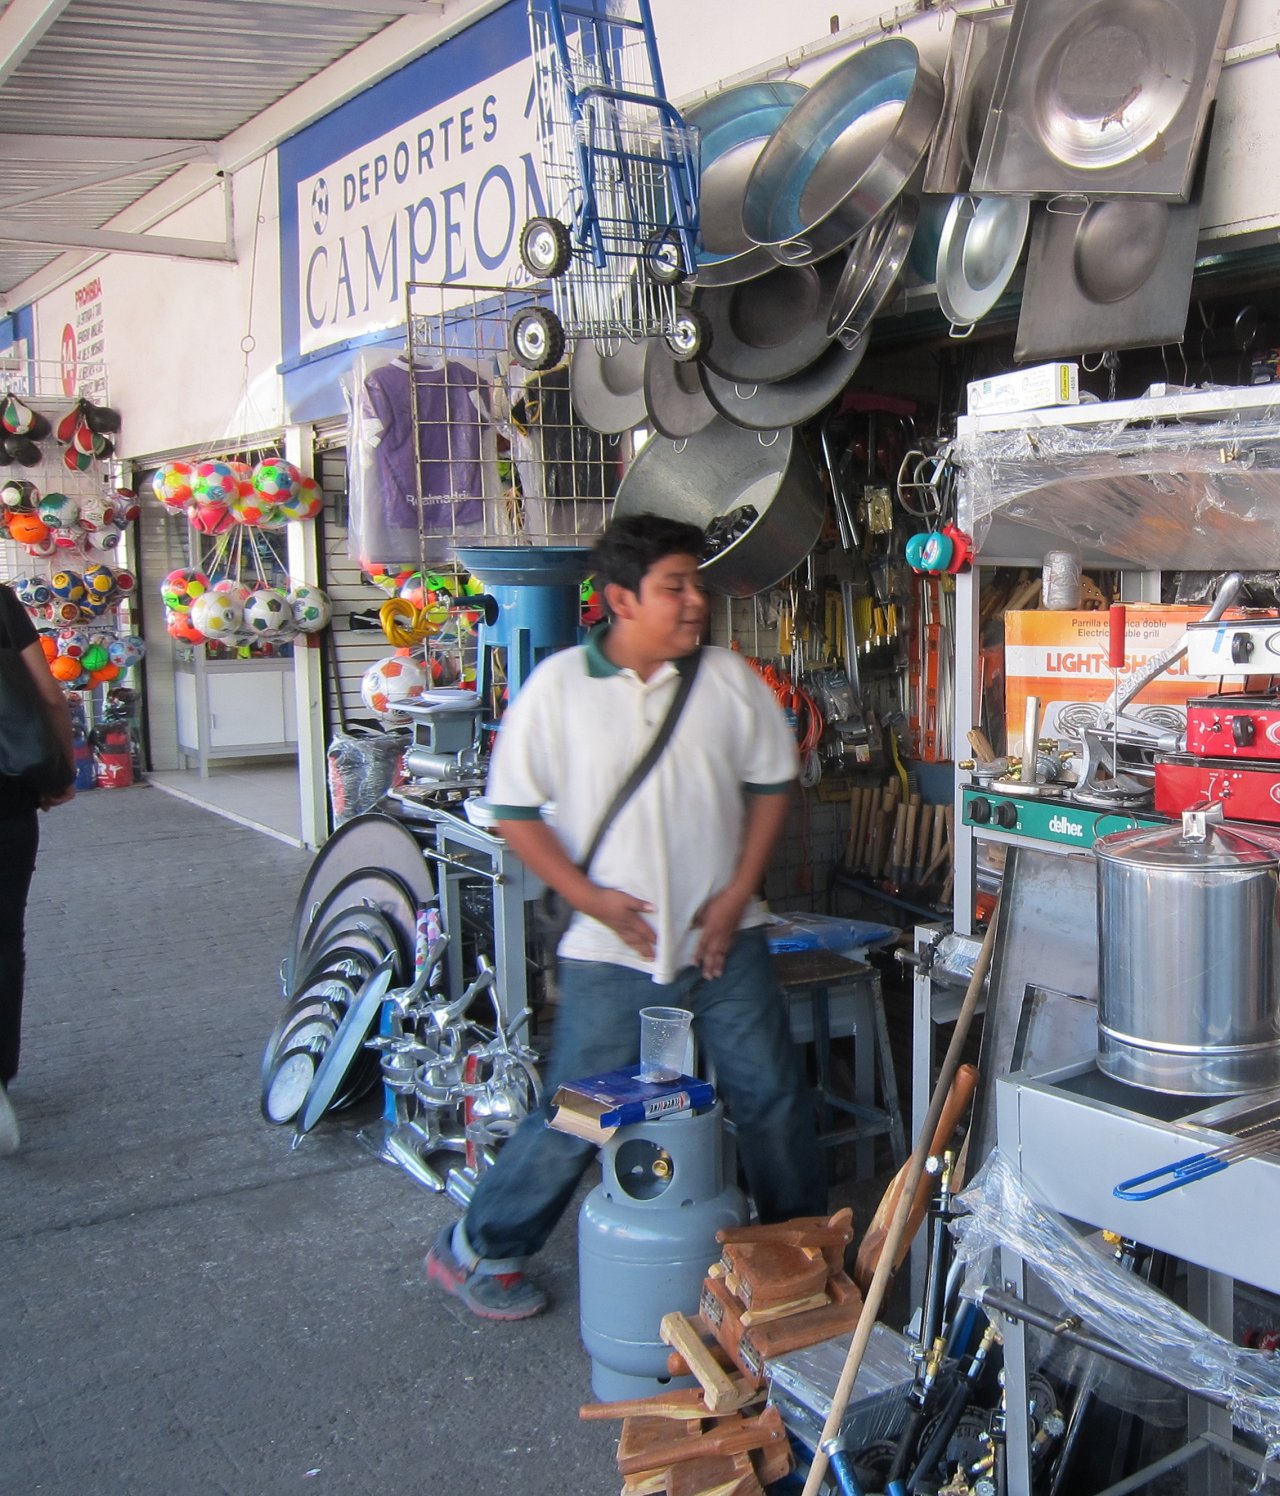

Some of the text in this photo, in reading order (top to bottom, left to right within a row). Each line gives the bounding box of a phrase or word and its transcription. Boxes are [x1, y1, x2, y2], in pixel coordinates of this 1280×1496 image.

[343, 93, 498, 213] DEPORTES
[1071, 618, 1101, 628] Parrilla
[1142, 617, 1167, 629] doble
[1078, 628, 1110, 638] Electric
[1143, 628, 1160, 640] grill
[1046, 652, 1189, 676] LIGHT SHCK
